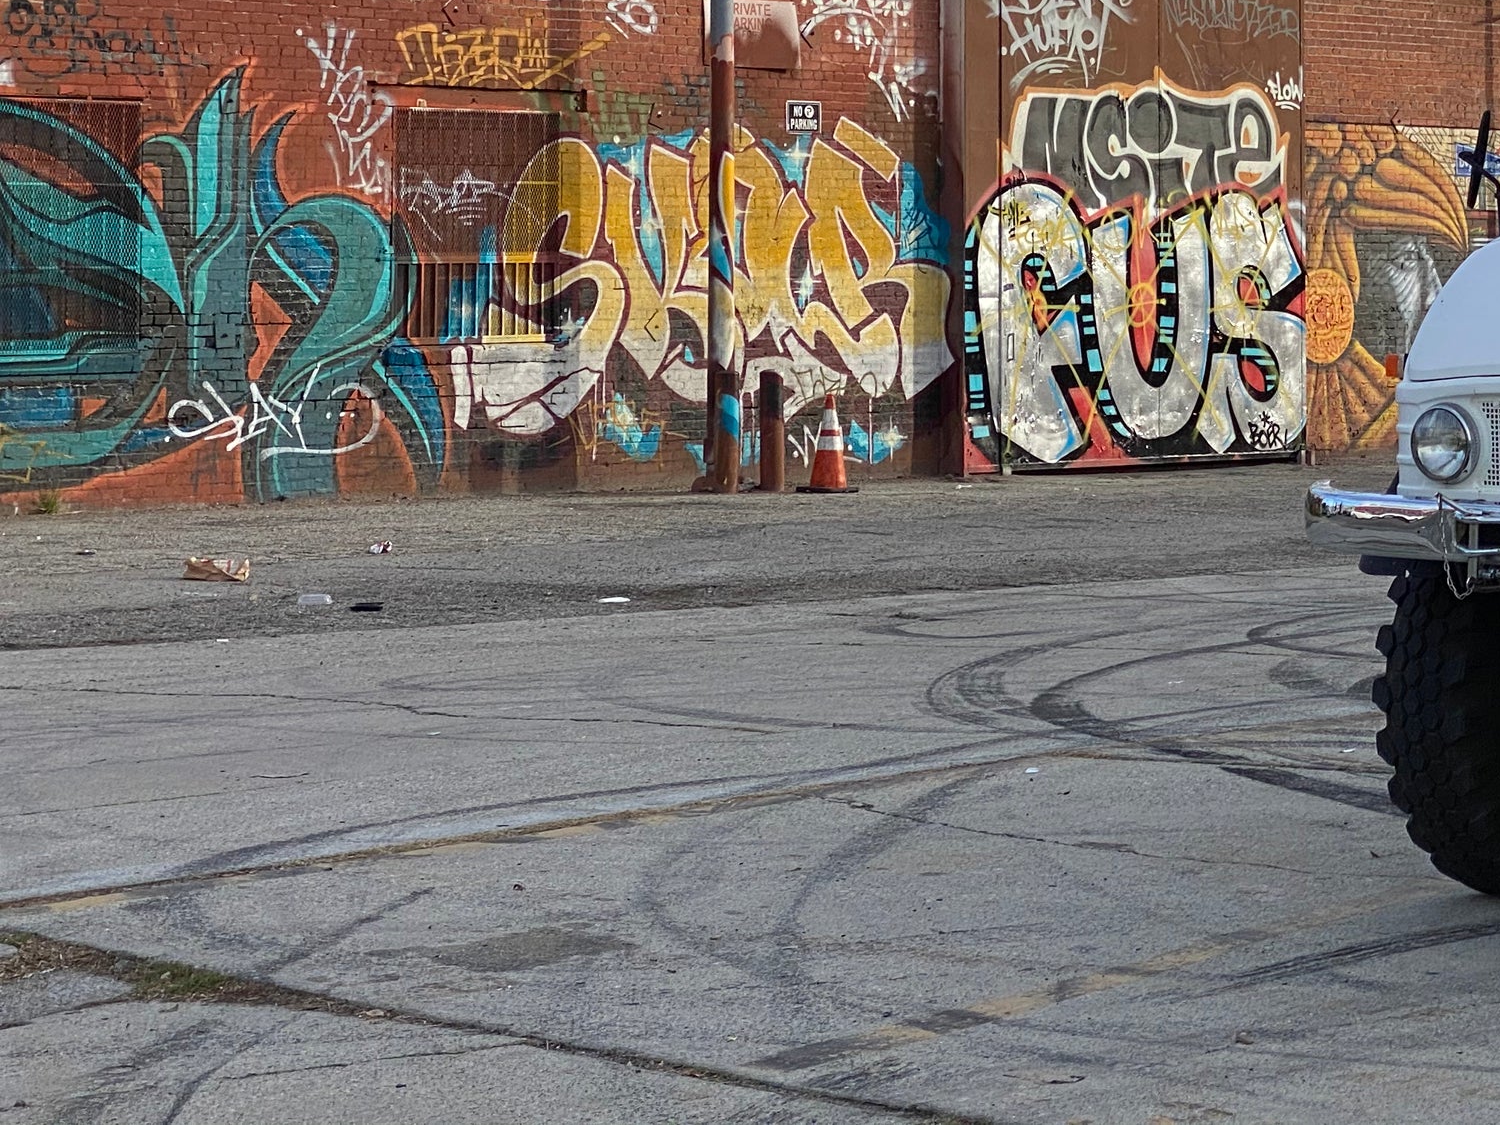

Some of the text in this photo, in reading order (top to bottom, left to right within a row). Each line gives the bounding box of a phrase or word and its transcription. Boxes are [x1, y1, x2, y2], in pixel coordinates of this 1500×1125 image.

[733, 2, 771, 16] RIVATE
[793, 105, 803, 117] NO
[790, 118, 818, 130] PARKING
